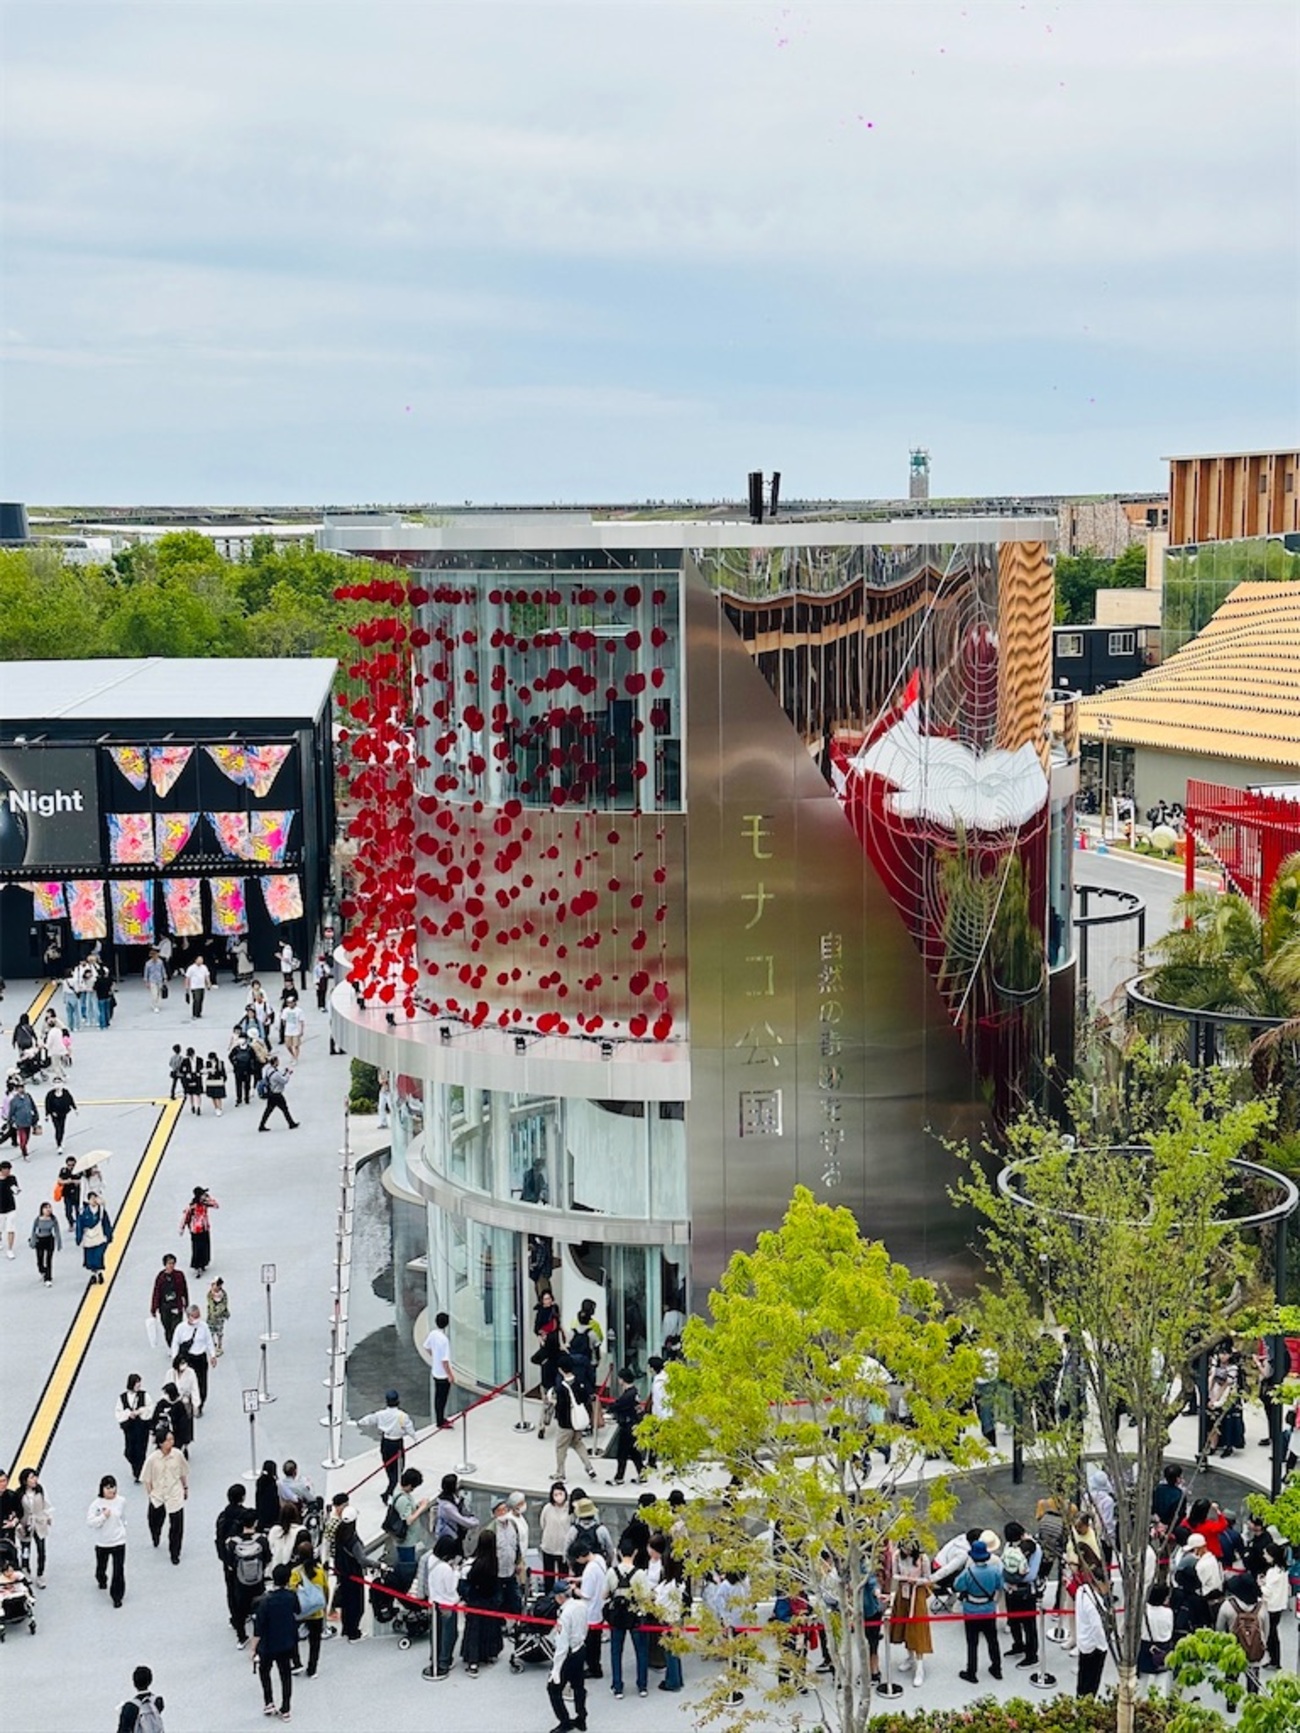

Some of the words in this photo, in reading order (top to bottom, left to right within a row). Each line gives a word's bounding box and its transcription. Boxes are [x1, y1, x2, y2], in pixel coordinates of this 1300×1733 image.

[9, 790, 83, 817] Night
[735, 815, 783, 1137] モナコ公国
